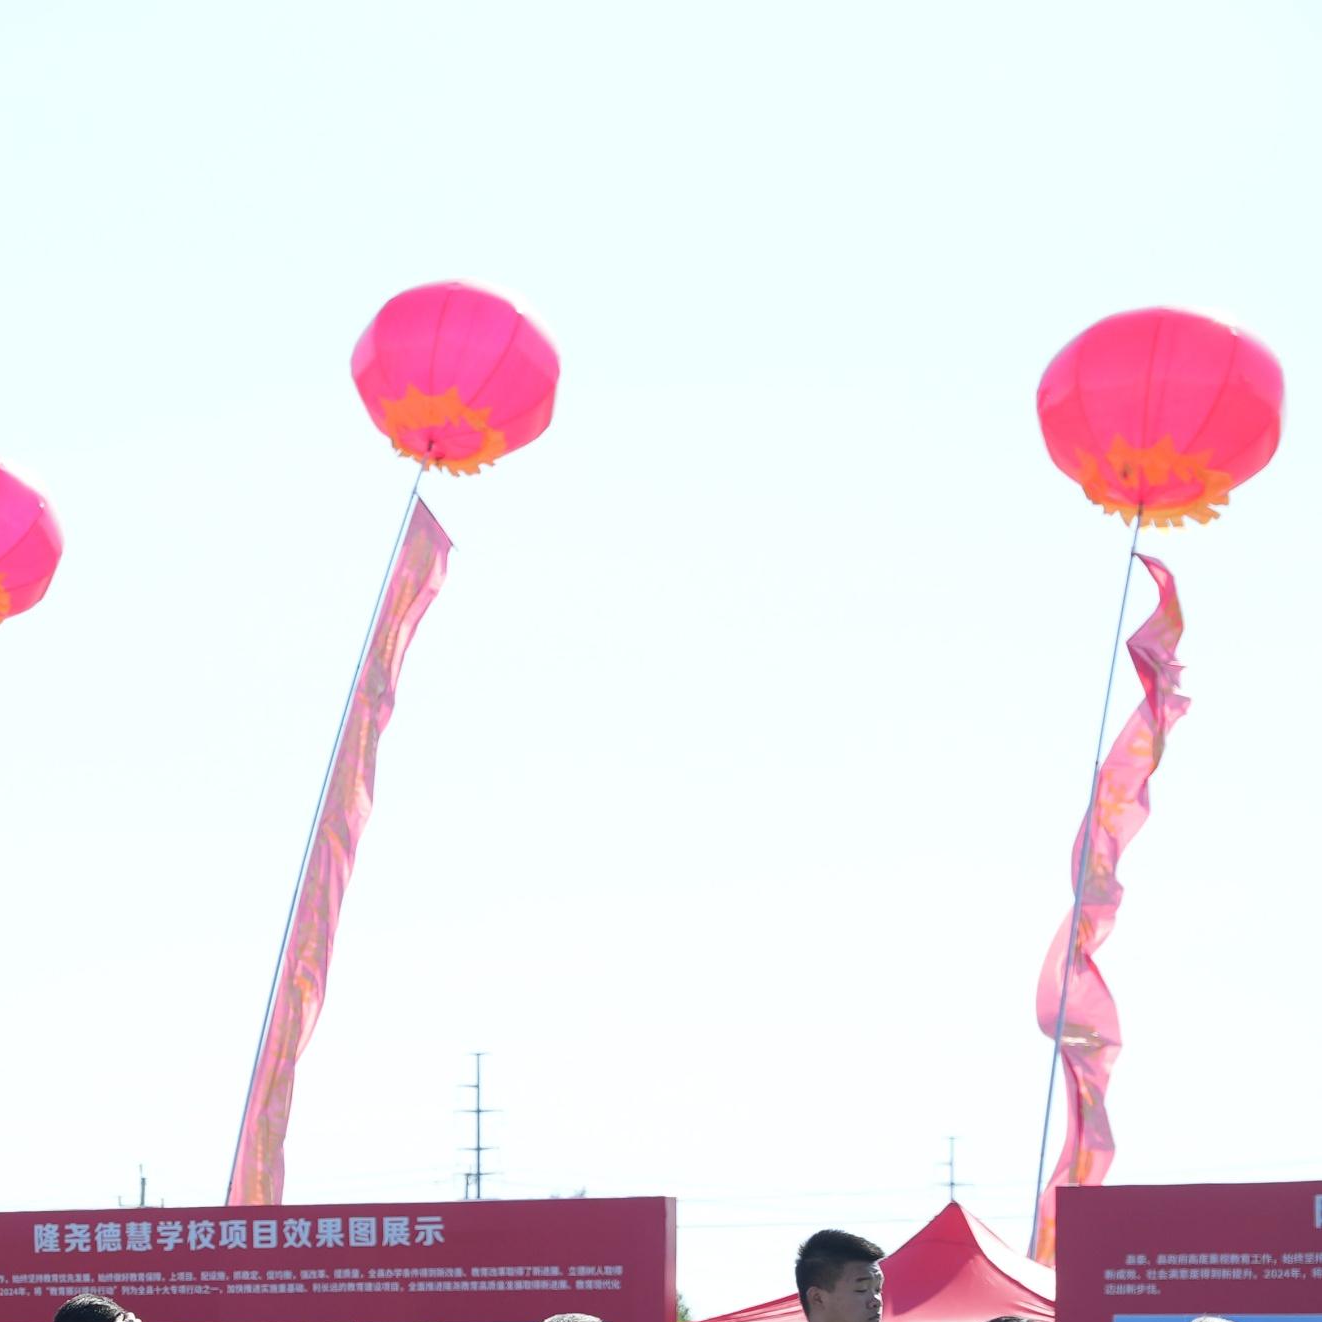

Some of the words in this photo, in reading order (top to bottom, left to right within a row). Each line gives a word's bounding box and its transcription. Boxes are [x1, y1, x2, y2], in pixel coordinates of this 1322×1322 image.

[33, 1216, 445, 1254] 隆尧德慧学校项目效果图展示
